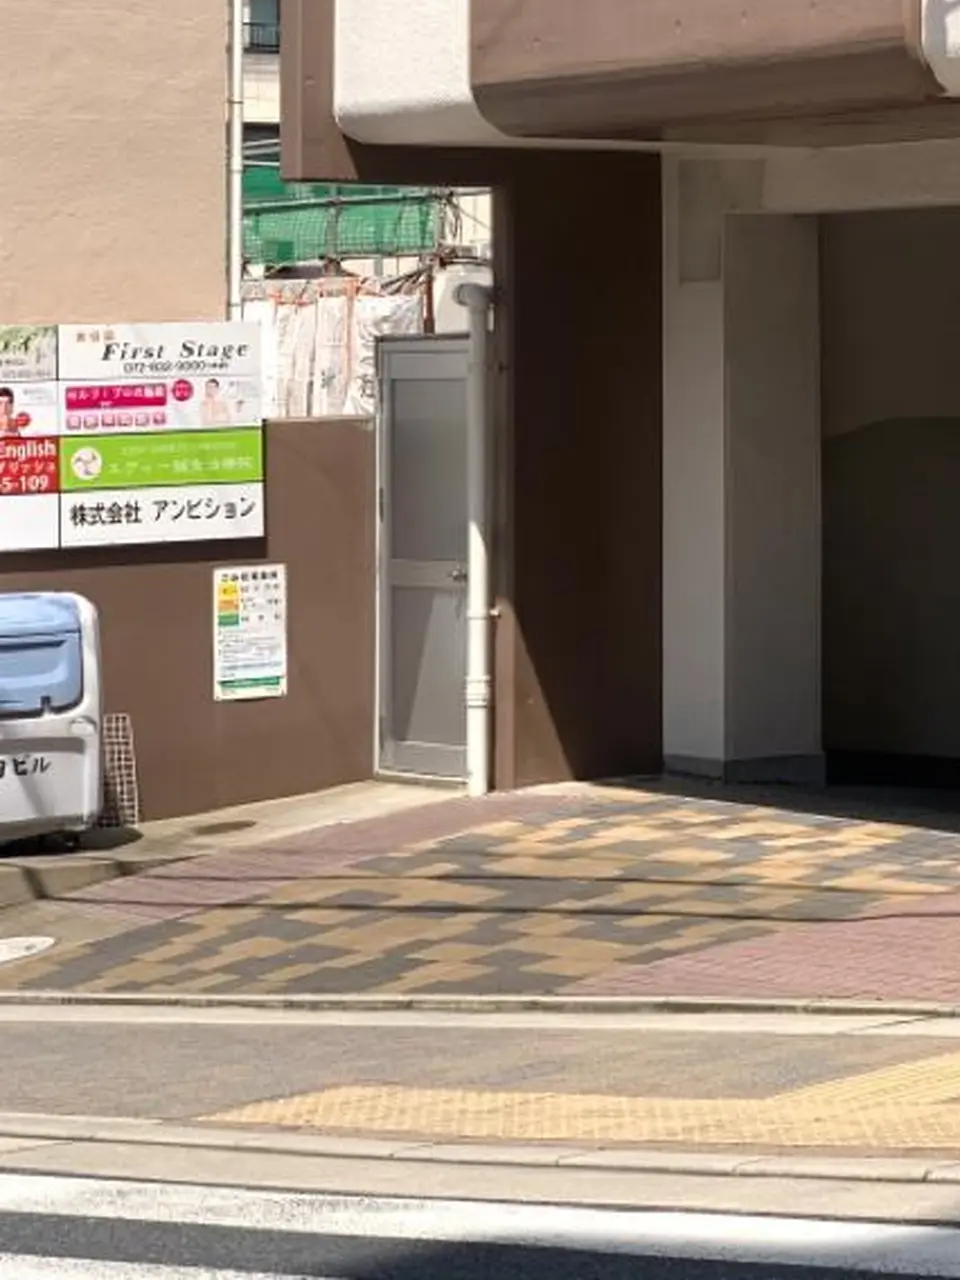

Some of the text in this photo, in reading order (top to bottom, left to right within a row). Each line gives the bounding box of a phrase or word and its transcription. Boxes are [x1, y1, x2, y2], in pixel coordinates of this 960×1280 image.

[102, 339, 250, 361] First Stage
[70, 500, 142, 527] 株式会社
